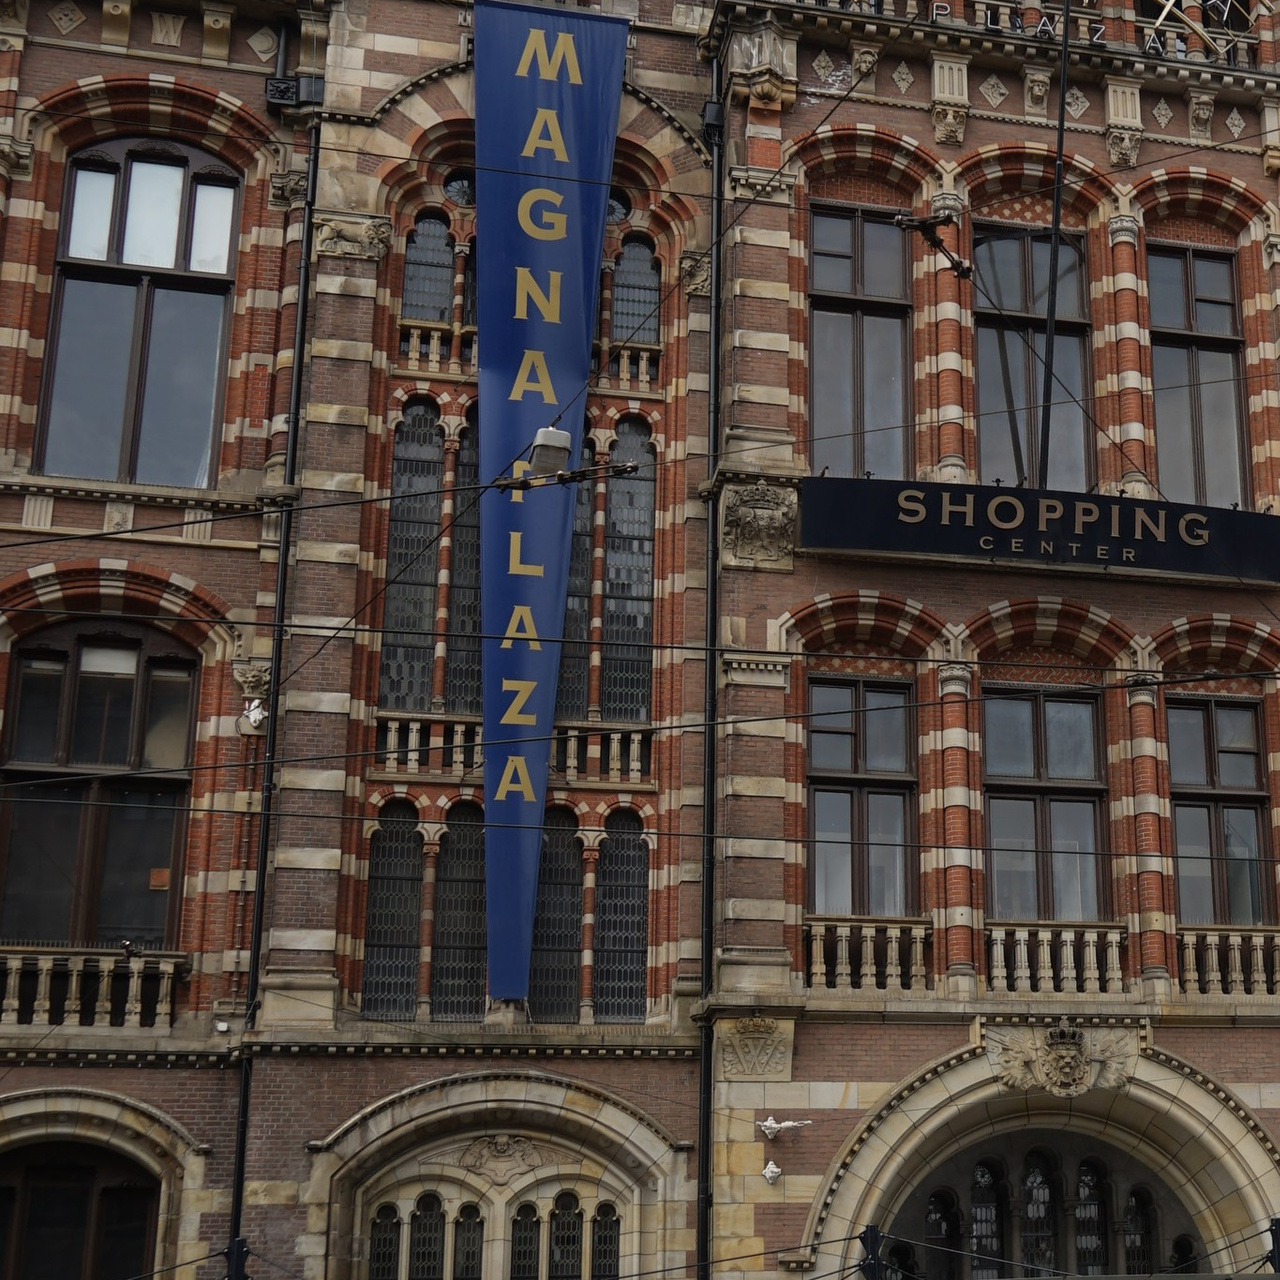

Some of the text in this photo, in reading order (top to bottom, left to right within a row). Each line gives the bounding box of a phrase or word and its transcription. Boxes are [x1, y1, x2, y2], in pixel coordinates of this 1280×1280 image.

[930, 2, 1166, 56] PLAZA
[507, 28, 584, 406] MAGNA
[896, 488, 1212, 548] SHOPPING
[978, 535, 1138, 563] CENTER
